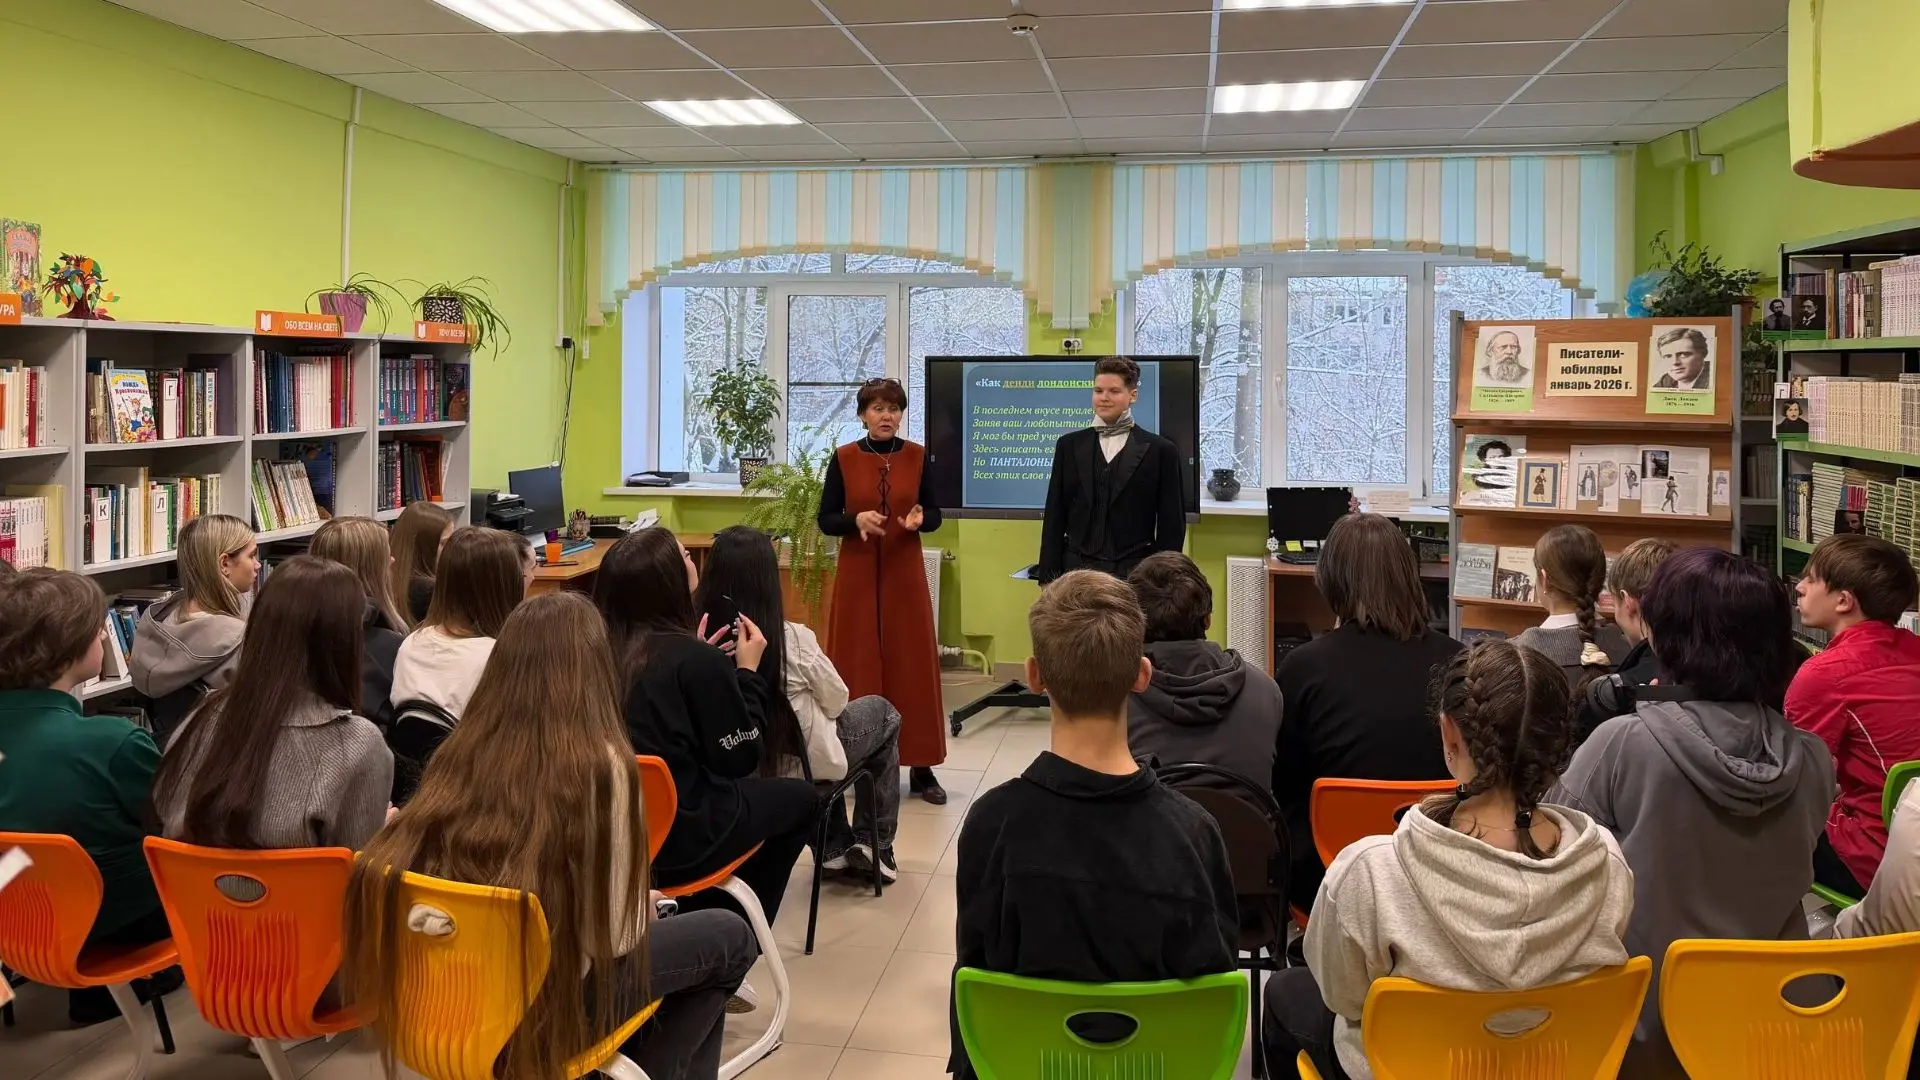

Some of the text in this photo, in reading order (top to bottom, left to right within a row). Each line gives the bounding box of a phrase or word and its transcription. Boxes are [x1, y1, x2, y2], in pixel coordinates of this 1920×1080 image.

[285, 320, 297, 330] ОБО
[1560, 348, 1625, 359] Писатели-
[1560, 364, 1622, 375] юбиляры
[975, 378, 1095, 389] «Как денди лондонски
[1550, 380, 1632, 391] январь 2026 г.
[973, 405, 980, 414] В
[982, 405, 1032, 415] последнем
[1034, 407, 1060, 416] вкусе
[972, 419, 1001, 428] Заняв
[1002, 420, 1022, 428] ваш
[972, 431, 980, 440] Я
[981, 432, 1000, 441] мог
[1001, 431, 1014, 440] бы
[1016, 431, 1040, 442] пред
[972, 444, 998, 454] Здесь
[1001, 445, 1042, 453] описать
[973, 457, 985, 466] Но
[973, 470, 994, 480] Всех
[995, 472, 1020, 480] этих
[1022, 472, 1043, 480] слов
[157, 497, 164, 509] Л
[100, 504, 107, 517] К
